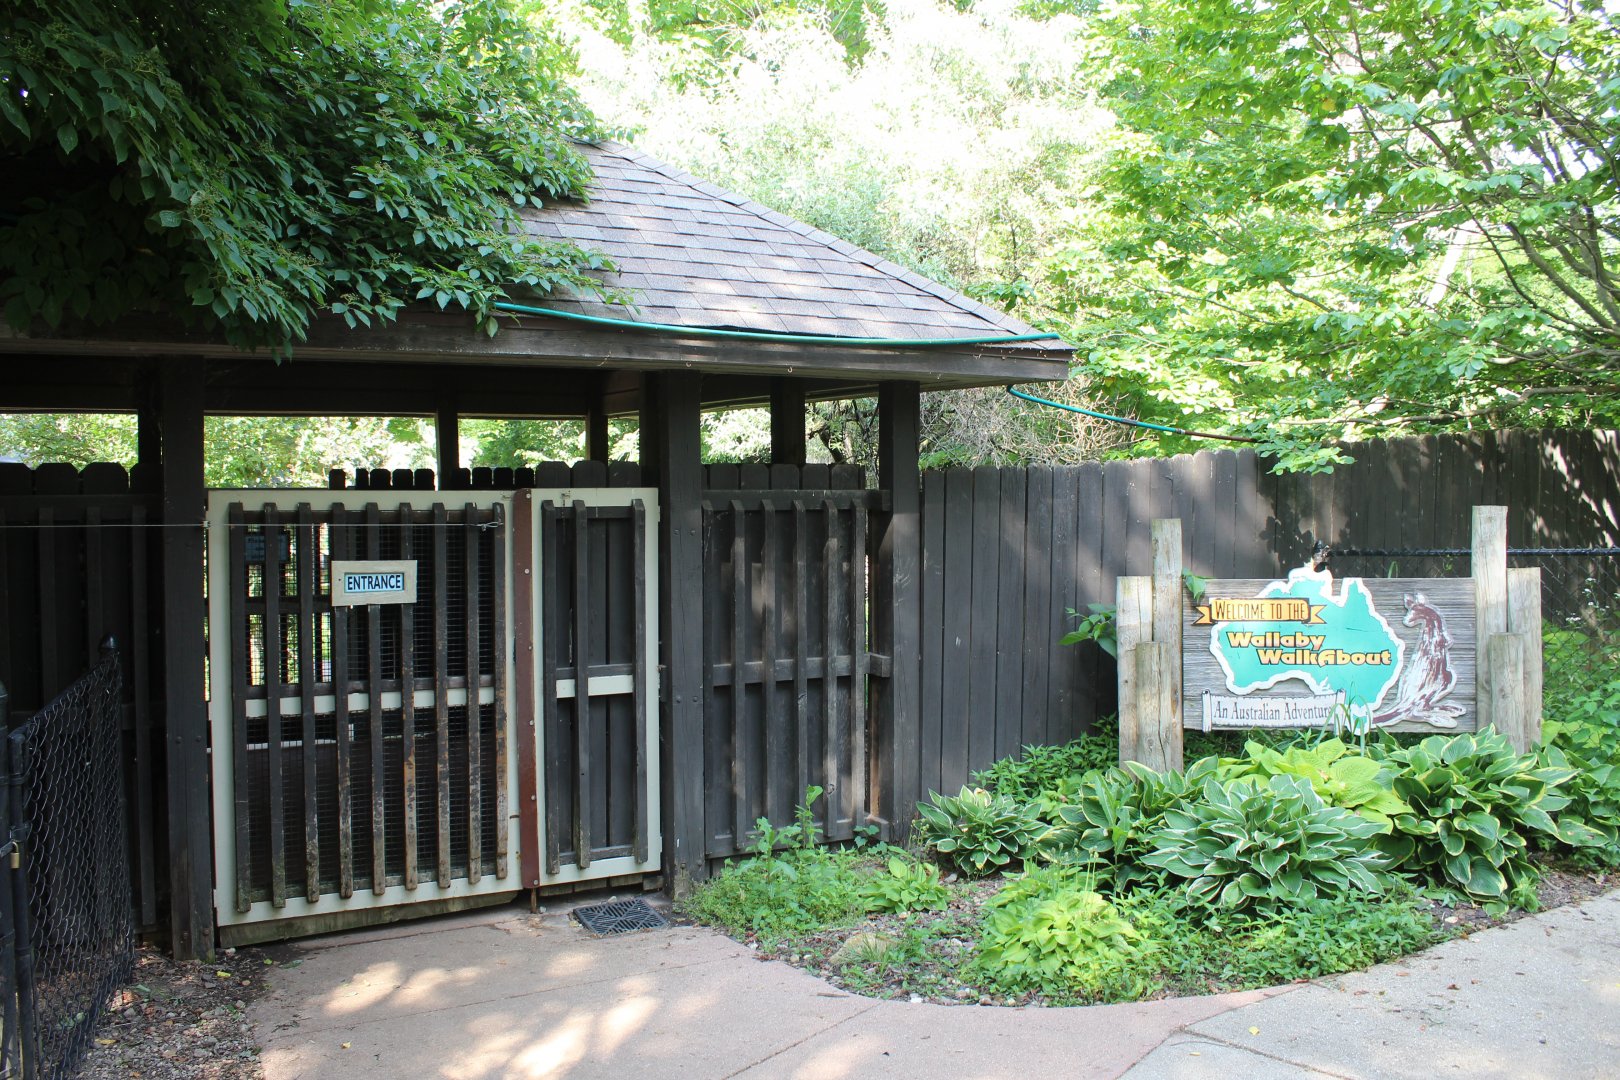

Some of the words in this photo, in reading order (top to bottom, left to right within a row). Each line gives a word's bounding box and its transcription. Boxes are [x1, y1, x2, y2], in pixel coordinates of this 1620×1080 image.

[347, 575, 401, 590] ENTRANCE
[1215, 601, 1265, 619] WELCOME
[1270, 603, 1282, 619] TO
[1287, 603, 1305, 619] THE
[1226, 631, 1326, 650] Wallaby
[1256, 648, 1392, 667] WalkAbout
[1214, 701, 1228, 719] An
[1231, 702, 1280, 720] Australian
